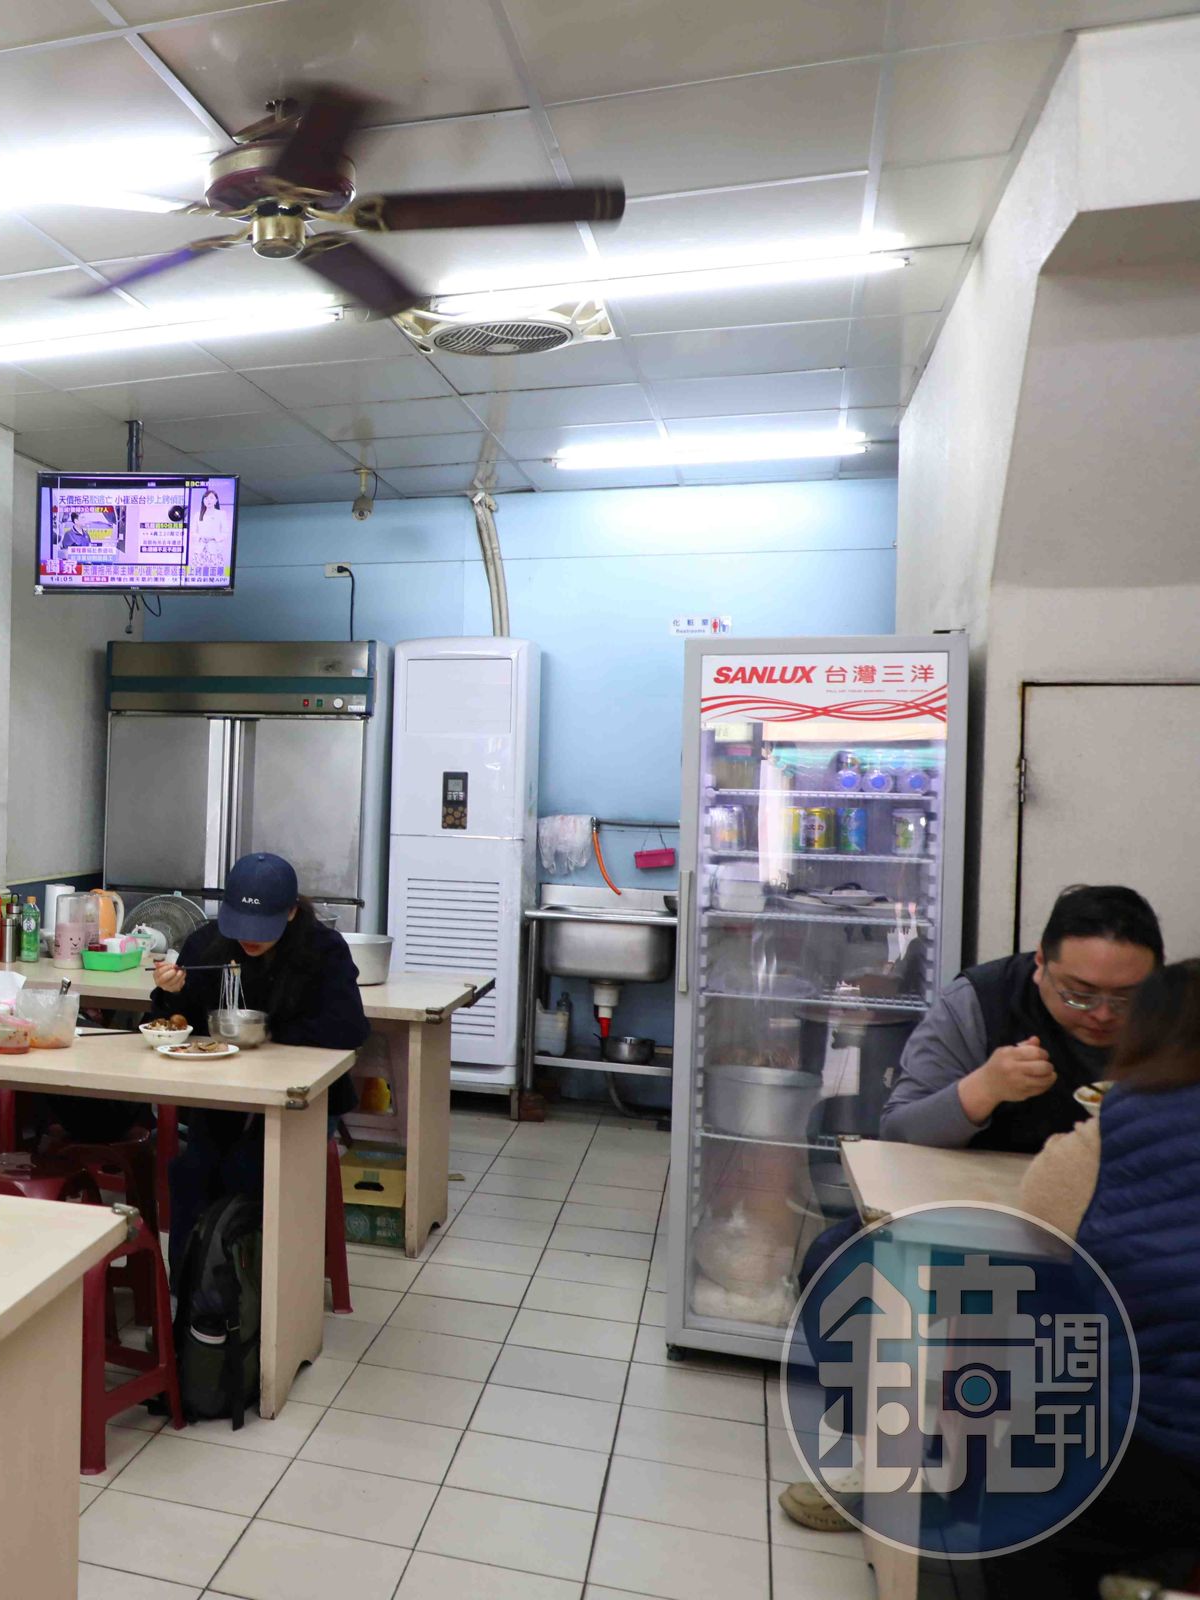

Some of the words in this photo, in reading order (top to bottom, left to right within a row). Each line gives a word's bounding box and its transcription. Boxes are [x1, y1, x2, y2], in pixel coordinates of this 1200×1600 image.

[713, 665, 817, 684] SANLUX
[825, 664, 935, 684] 台灣三洋
